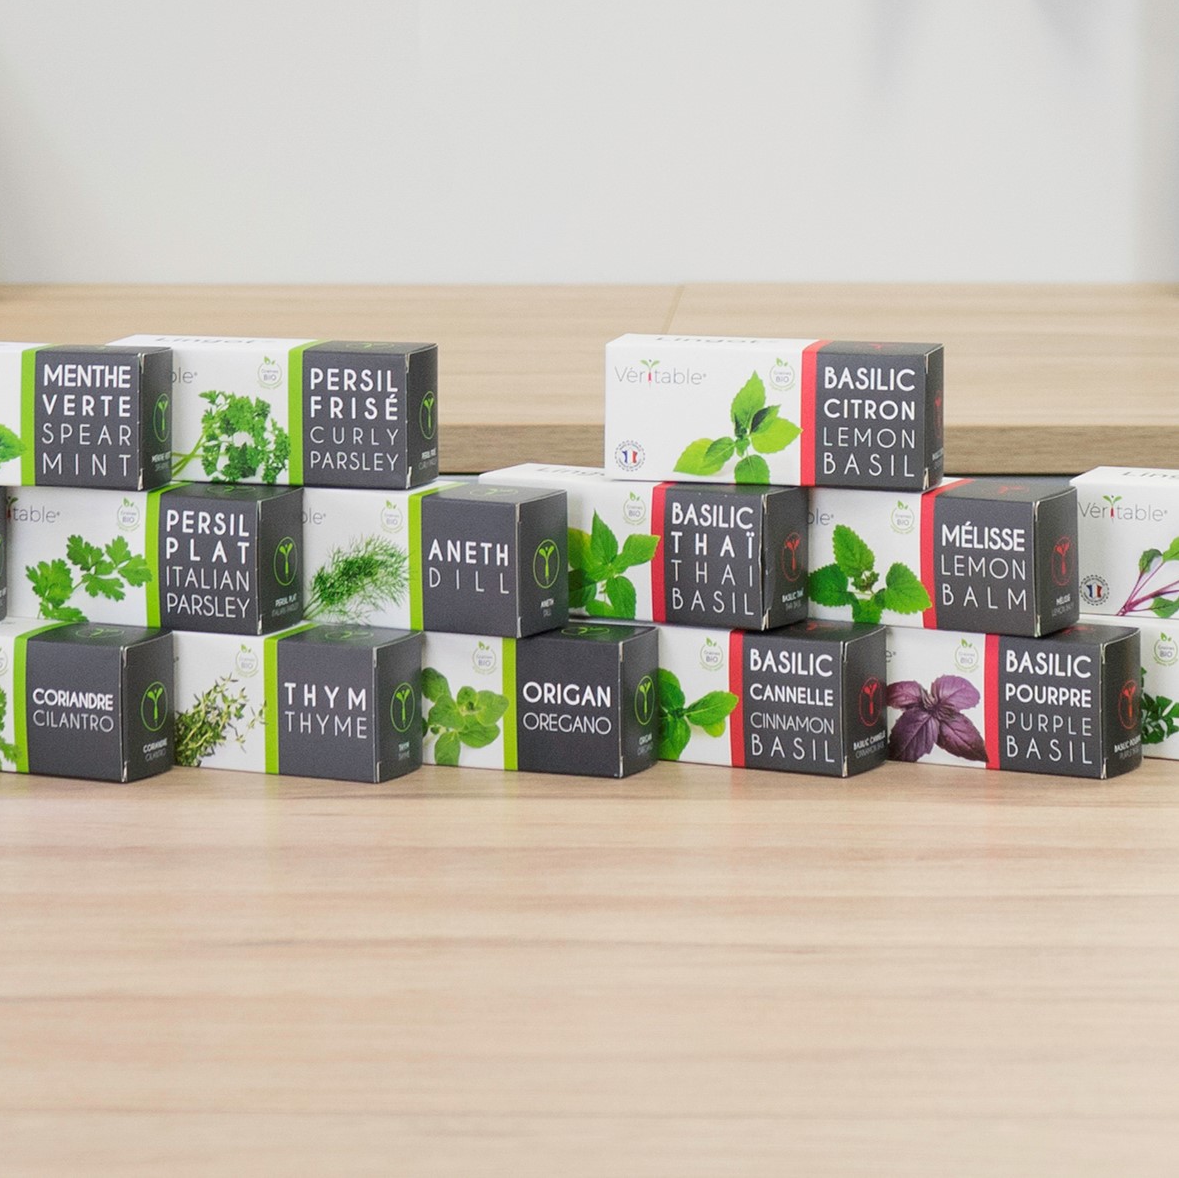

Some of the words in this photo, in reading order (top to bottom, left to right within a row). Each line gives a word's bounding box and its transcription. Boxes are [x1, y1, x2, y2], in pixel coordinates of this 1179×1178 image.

[44, 364, 130, 388] MENTHE
[311, 368, 398, 392] PERSIL
[825, 367, 915, 391] BASILIC
[43, 394, 130, 417] VERTE
[311, 394, 397, 420] FRISÉ
[824, 399, 914, 420] CITRON
[42, 423, 131, 445] SPEAR
[310, 426, 398, 445] CURLY
[824, 427, 914, 448] LEMON
[43, 453, 131, 476] MINT
[311, 451, 398, 471] PARSLEY
[824, 452, 914, 477] BASIL
[167, 510, 249, 536] PERSIL
[672, 503, 753, 529] BASILIC
[671, 532, 754, 558] THAÏ
[942, 521, 1024, 551] MÉLISSE
[167, 537, 249, 564] PLAT
[429, 539, 508, 566] ANETH
[167, 566, 249, 591] ITALIAN
[672, 560, 752, 586] THAI
[942, 555, 1025, 580] LEMON
[429, 567, 509, 594] DILL
[167, 593, 249, 618] PARSLEY
[673, 588, 754, 615] BASIL
[943, 584, 1026, 610] BALM
[751, 649, 832, 677] BASILIC
[1006, 650, 1091, 678] BASILIC
[33, 688, 113, 712] CORIANDRE
[285, 683, 366, 711] THYM
[523, 682, 610, 707] ORIGAN
[750, 684, 833, 706] CANNELLE
[1006, 683, 1091, 707] POURPRE
[33, 709, 113, 732] CILANTRO
[285, 711, 366, 738] THYME
[523, 713, 611, 734] OREGANO
[751, 712, 834, 736] CINNAMON
[1006, 712, 1091, 736] PURPLE
[752, 734, 834, 762] BASIL
[1007, 736, 1092, 764] BASIL
